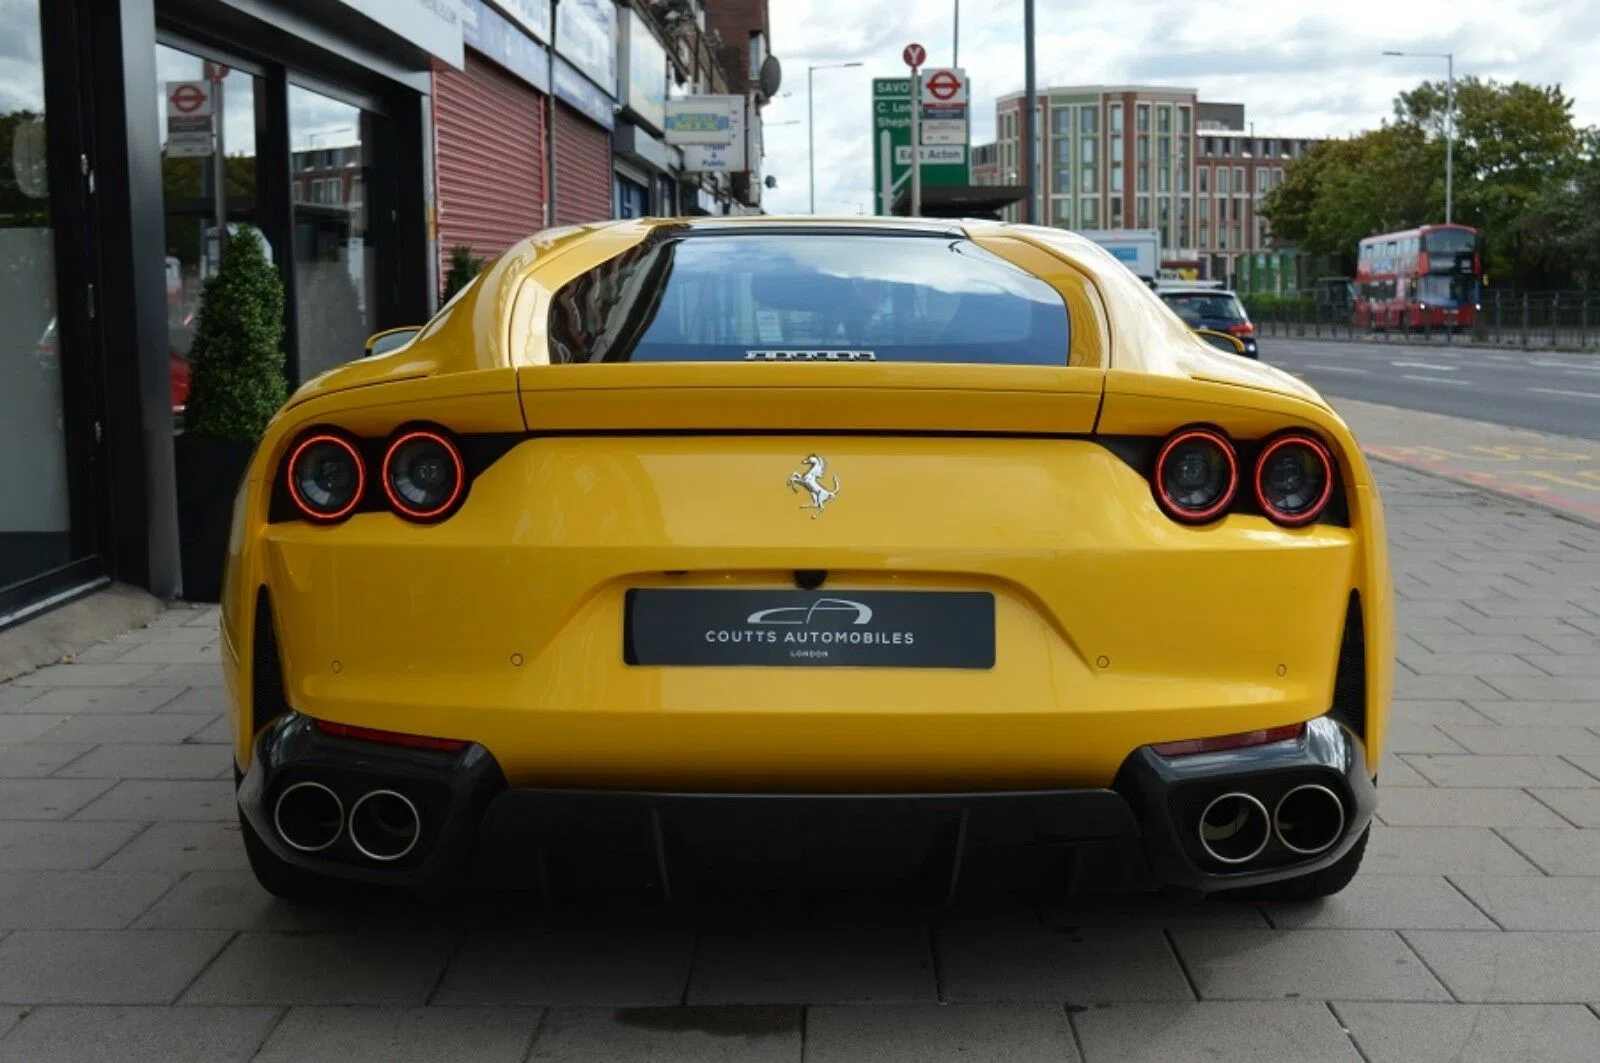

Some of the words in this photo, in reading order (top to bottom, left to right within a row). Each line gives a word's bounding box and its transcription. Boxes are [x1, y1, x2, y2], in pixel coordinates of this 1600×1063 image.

[907, 47, 922, 65] Y
[876, 83, 911, 93] SAVO
[878, 117, 913, 128] Sheph
[900, 150, 925, 160] Eat
[928, 149, 961, 160] Acton
[705, 630, 777, 643] COUTTS
[784, 631, 915, 645] AUTOMOBILES
[790, 649, 829, 658] LONDON
